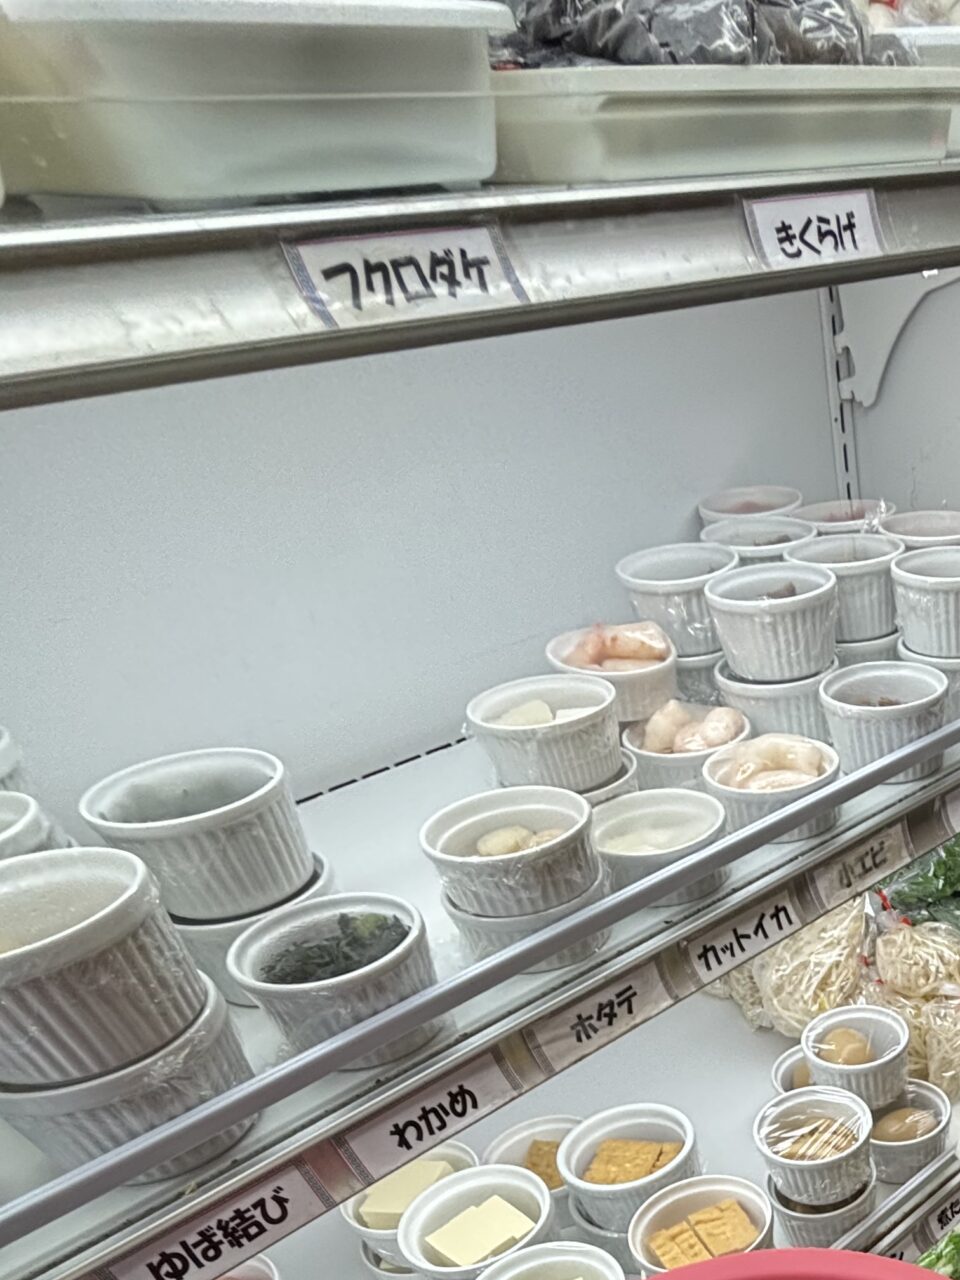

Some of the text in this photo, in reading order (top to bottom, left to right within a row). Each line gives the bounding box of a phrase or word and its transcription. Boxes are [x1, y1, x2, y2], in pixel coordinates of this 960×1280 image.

[775, 210, 859, 259] きくらげ
[320, 247, 490, 311] フクロダケ
[697, 904, 794, 972] カットイカ
[569, 984, 638, 1043] ホタテ
[389, 1084, 479, 1151] わかめ
